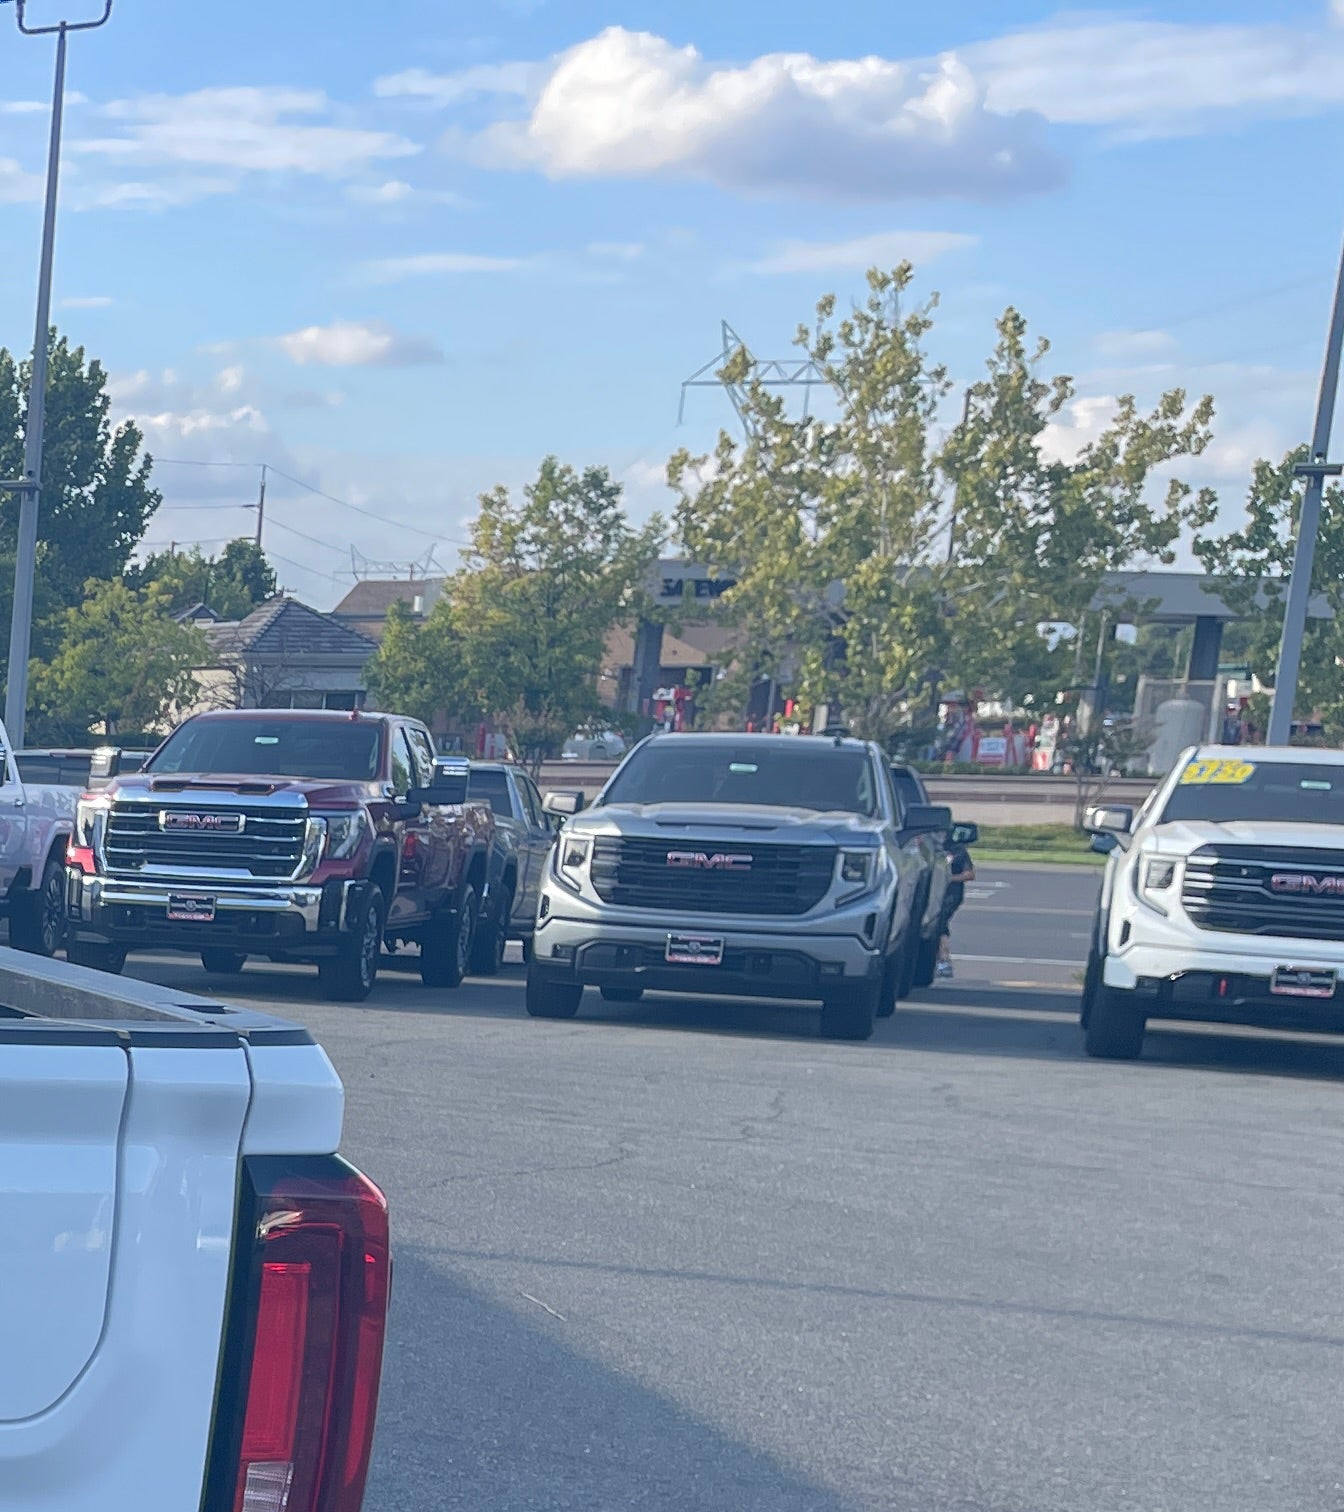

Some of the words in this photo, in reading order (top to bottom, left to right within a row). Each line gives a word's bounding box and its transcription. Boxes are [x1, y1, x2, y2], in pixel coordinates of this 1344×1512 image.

[166, 813, 239, 830] GMC
[666, 851, 753, 870] GMC
[1270, 873, 1344, 896] GM
